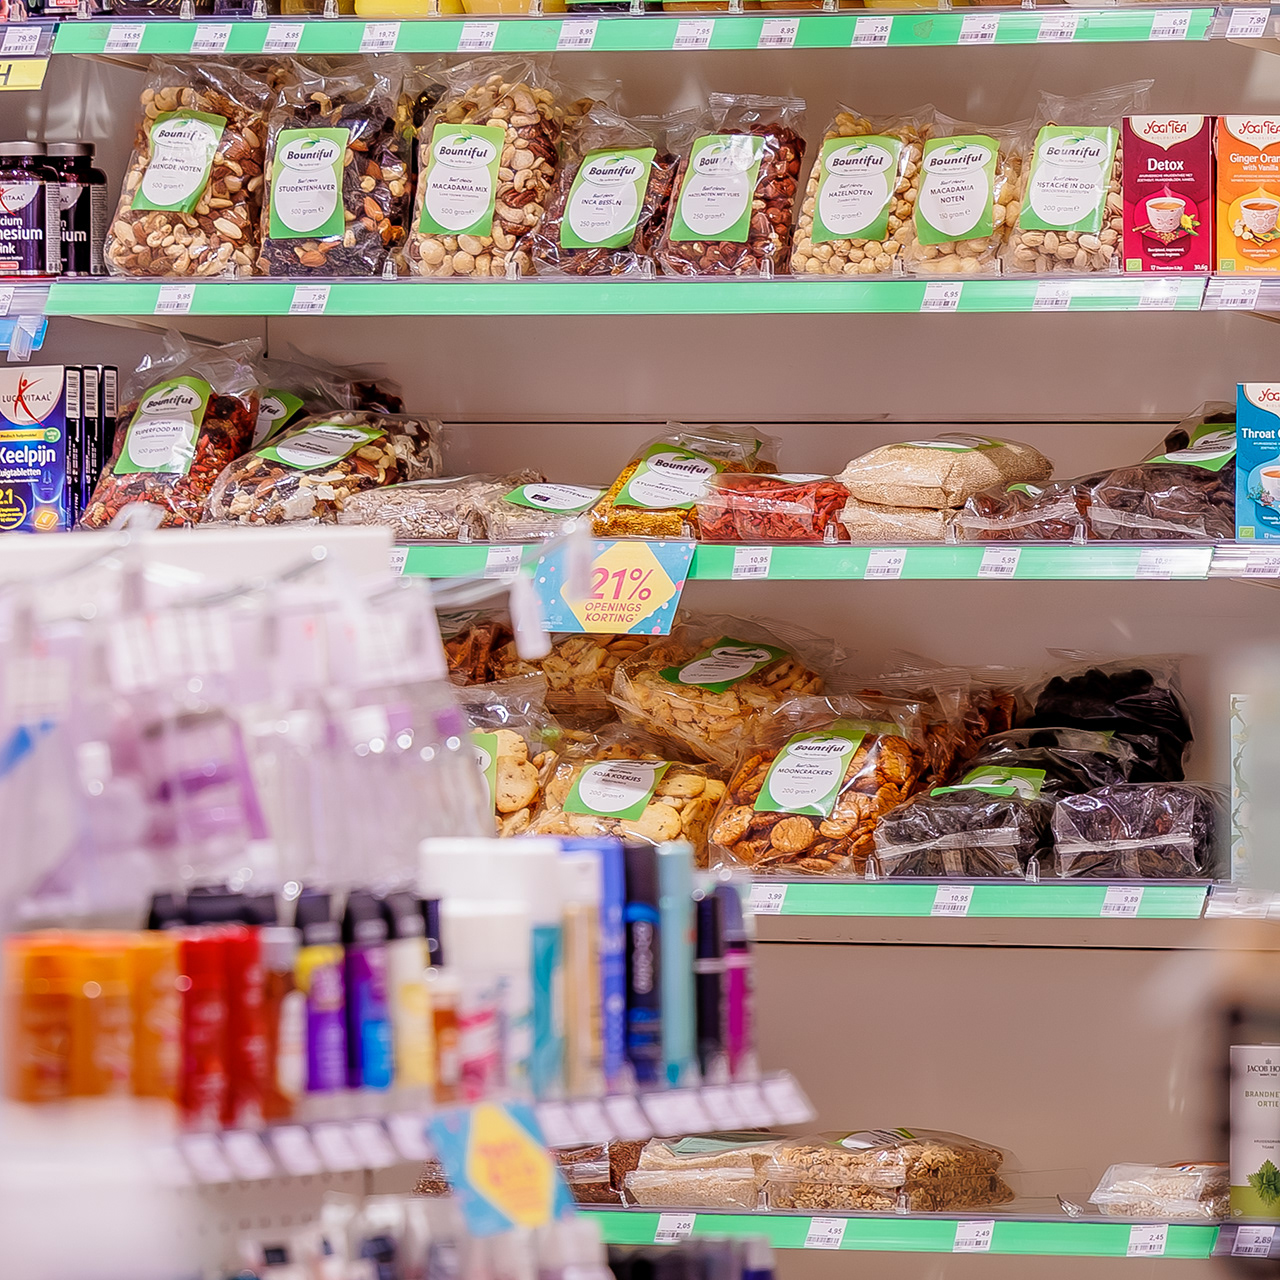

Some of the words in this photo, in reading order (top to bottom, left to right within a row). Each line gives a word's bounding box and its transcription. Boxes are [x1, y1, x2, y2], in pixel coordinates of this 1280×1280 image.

[1143, 120, 1168, 134] YOGI
[1168, 120, 1187, 133] TEA
[287, 148, 334, 162] Bountiful
[439, 145, 488, 159] Bountiful
[1148, 158, 1184, 171] Detox
[1230, 153, 1258, 165] Ginger
[278, 184, 335, 193] STUDENTENHAVER
[1242, 428, 1275, 439] Throat
[588, 568, 652, 601] 21%
[584, 602, 643, 614] OPENINGS
[949, 894, 969, 902] 10,95
[1257, 1100, 1280, 1108] ORTIE
